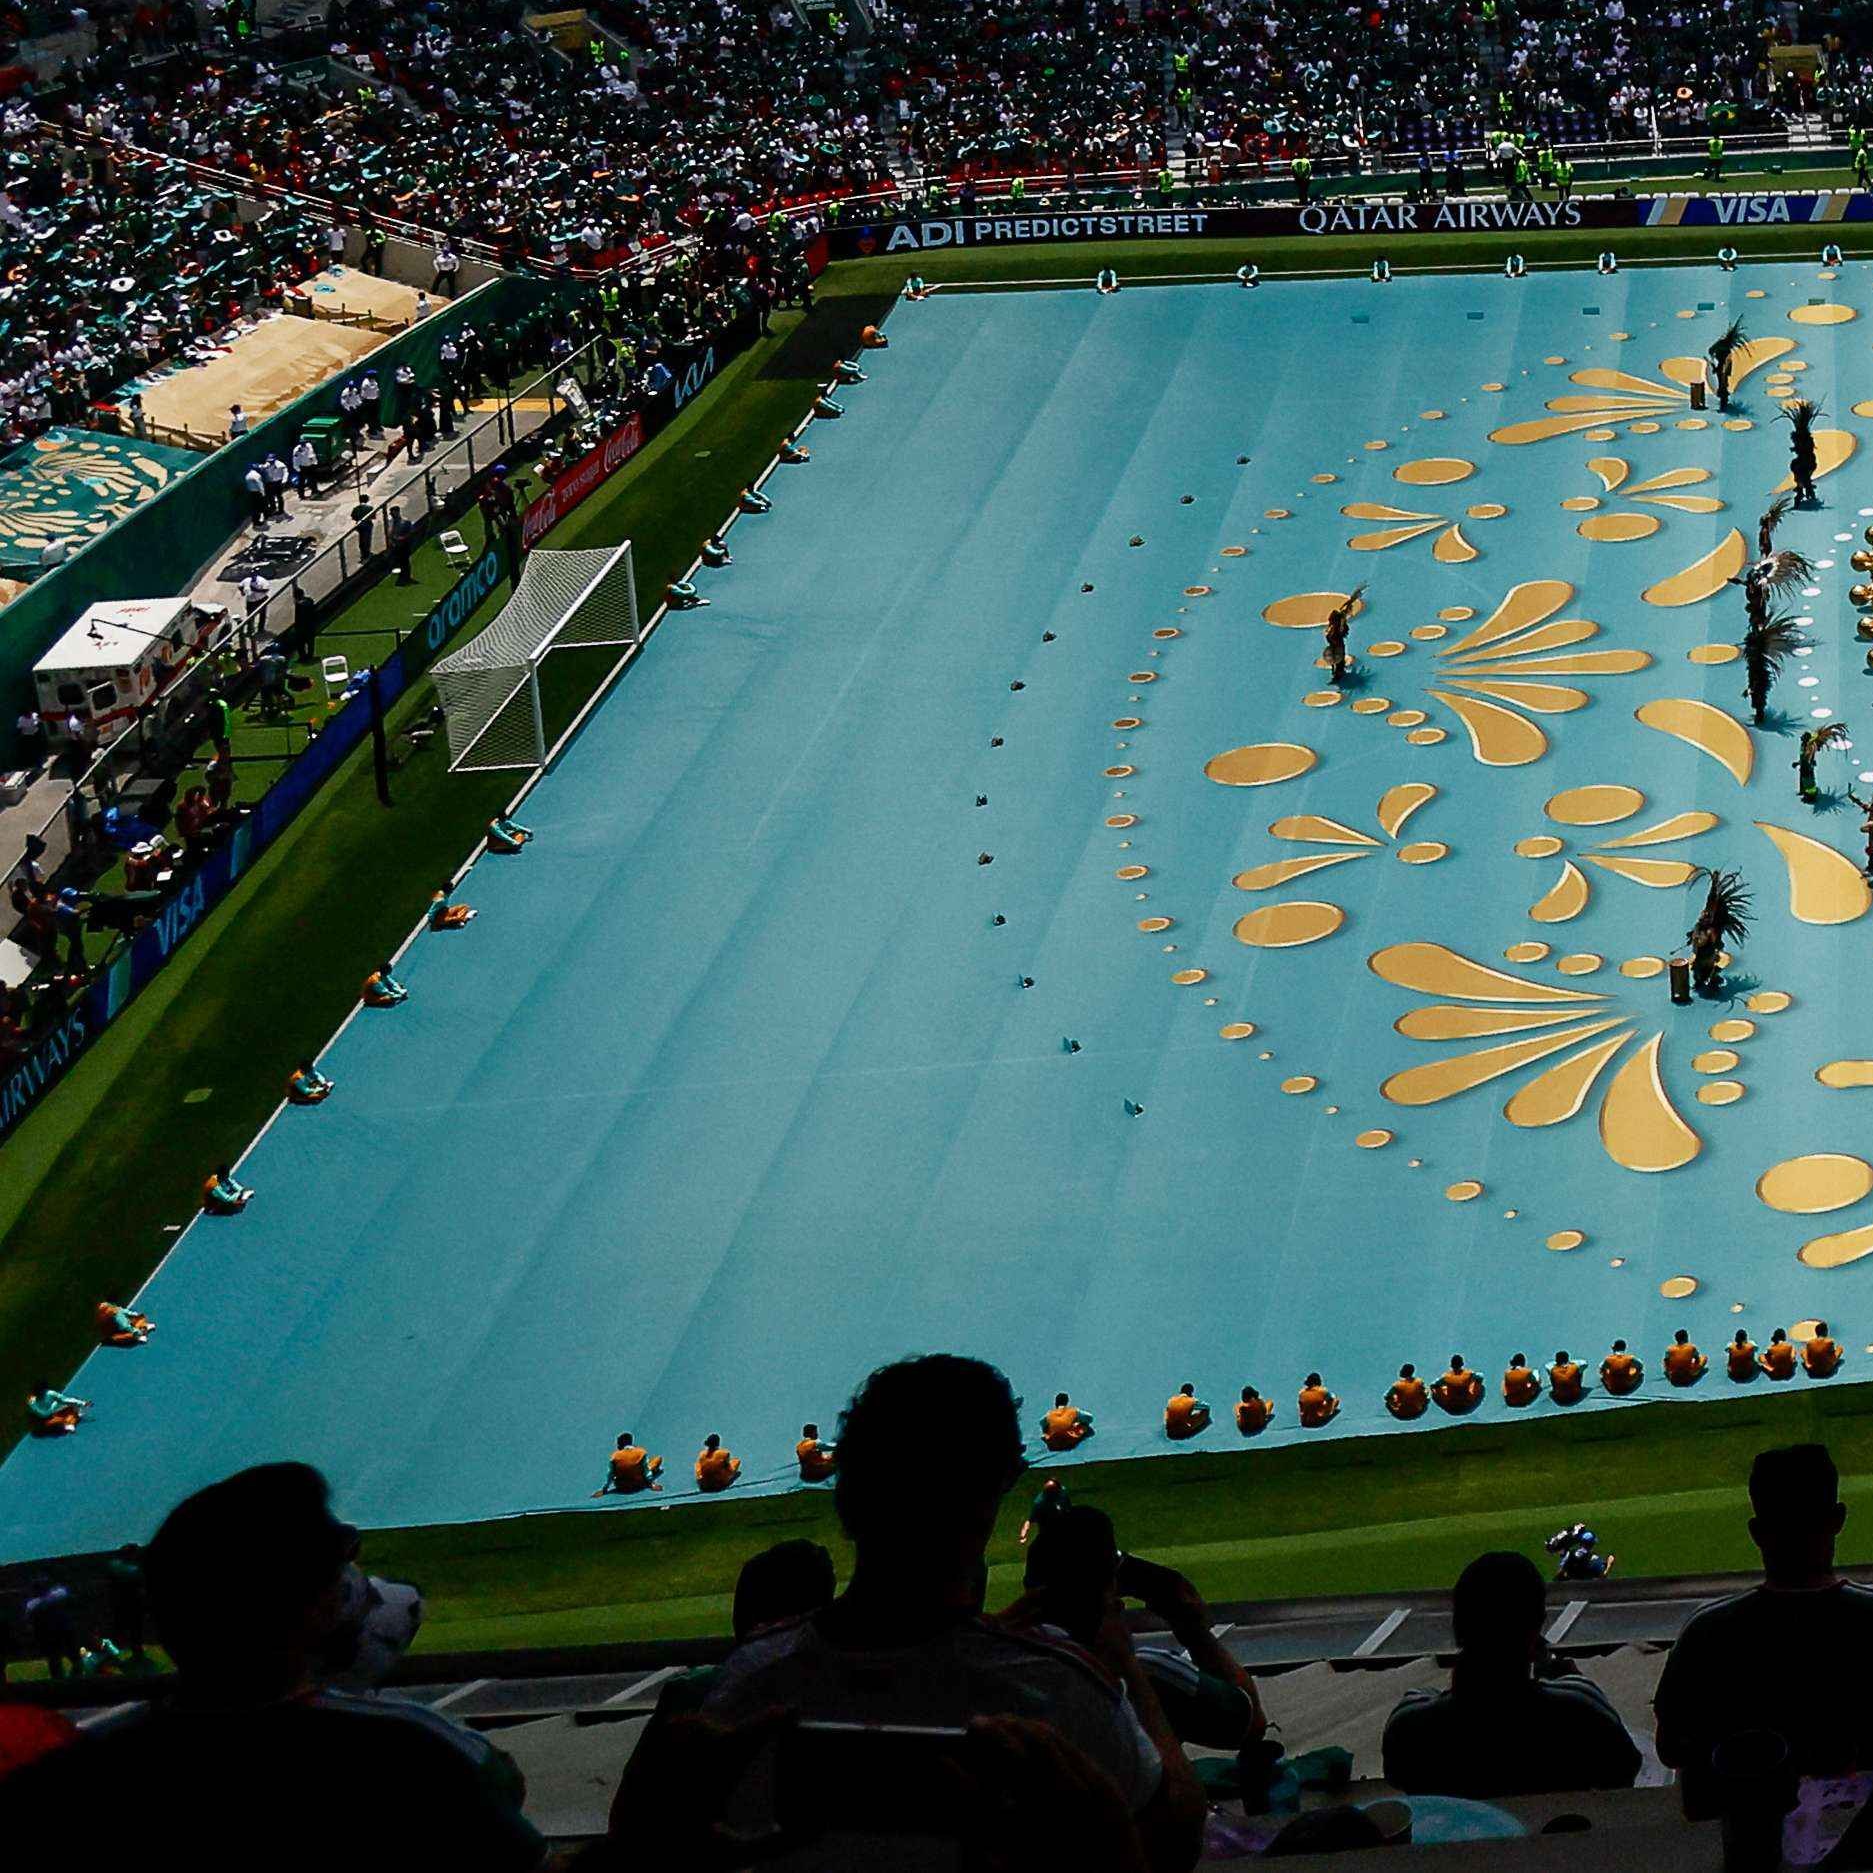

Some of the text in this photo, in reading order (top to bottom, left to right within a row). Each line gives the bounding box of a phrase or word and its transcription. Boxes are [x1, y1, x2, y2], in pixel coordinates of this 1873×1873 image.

[1300, 200, 1583, 234] QATAR AIRWAYS
[1711, 195, 1792, 224] VISA
[886, 213, 1209, 252] ADI PREDICTSTREET
[152, 871, 207, 957] VISA
[0, 1008, 88, 1132] IRWAYS
